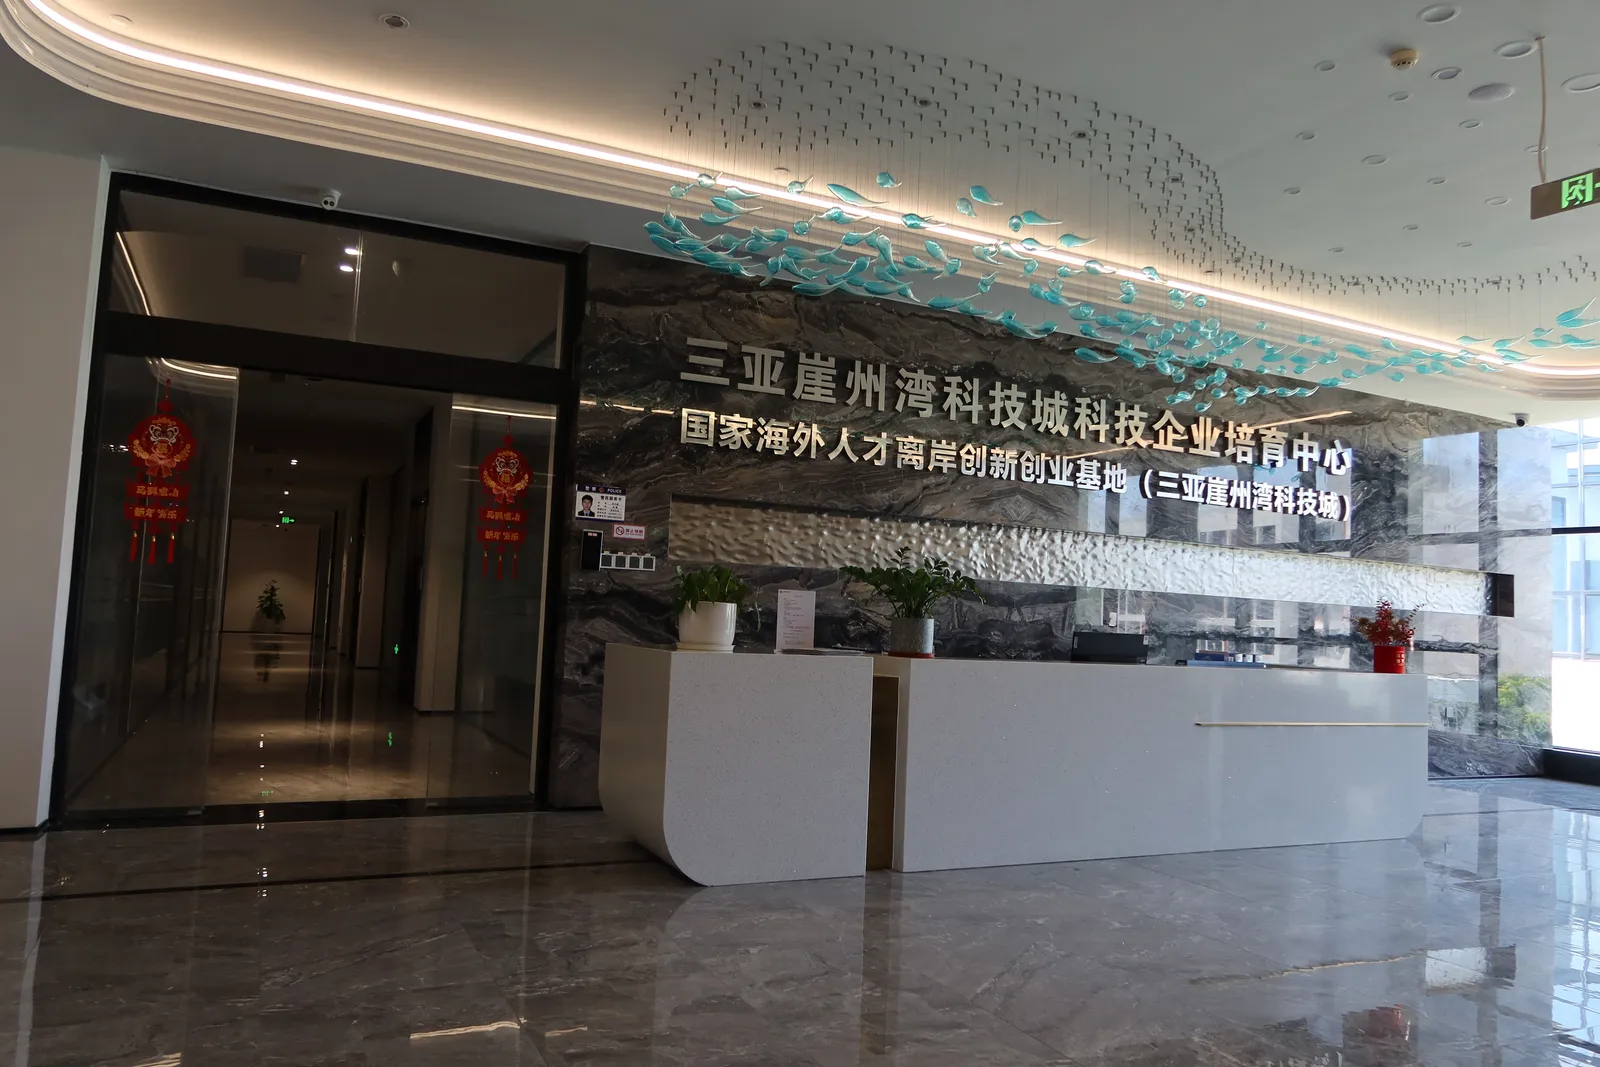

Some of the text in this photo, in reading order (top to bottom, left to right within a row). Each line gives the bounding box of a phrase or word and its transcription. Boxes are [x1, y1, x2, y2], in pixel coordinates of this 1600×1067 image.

[680, 337, 1352, 475] 三亚崖州湾科技城科技企业培育中心
